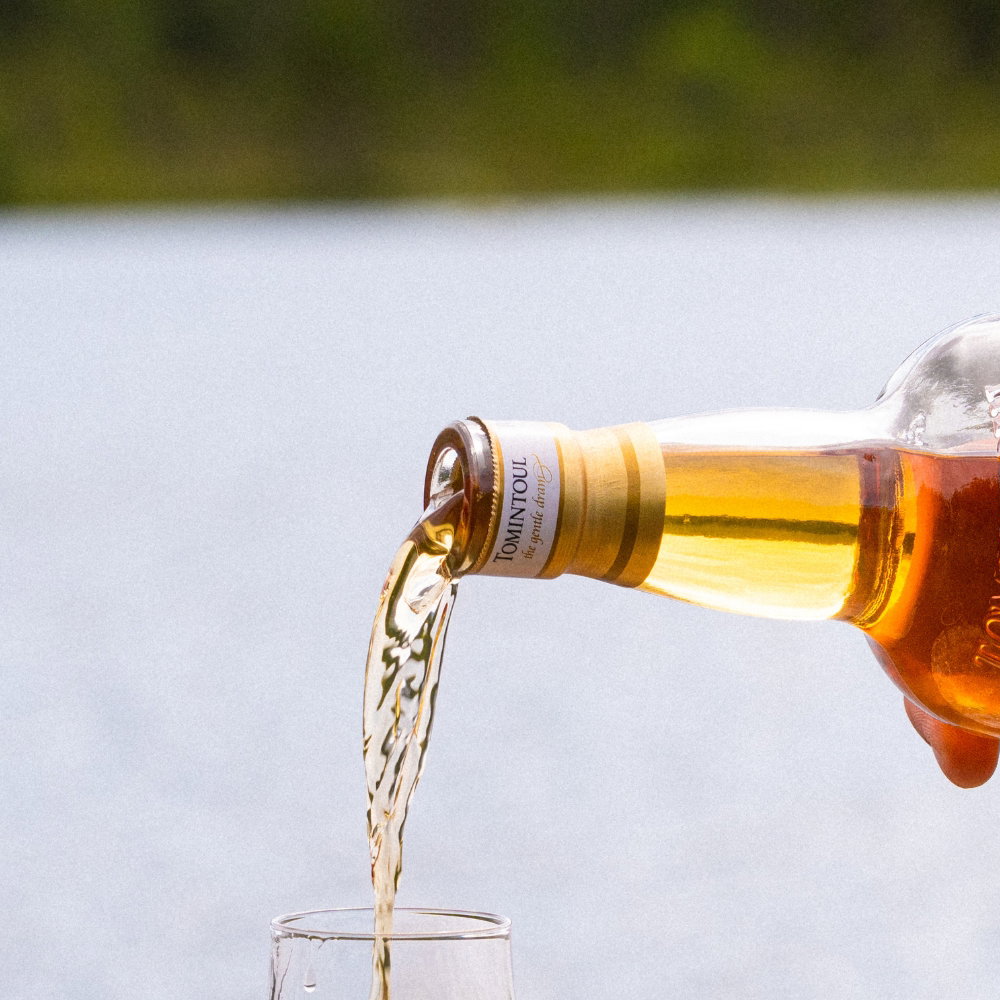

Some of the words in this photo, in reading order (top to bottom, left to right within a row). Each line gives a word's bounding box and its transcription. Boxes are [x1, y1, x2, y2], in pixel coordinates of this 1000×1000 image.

[492, 456, 528, 563] TOMINTOUL
[528, 511, 544, 544] gentle
[522, 545, 537, 560] the
